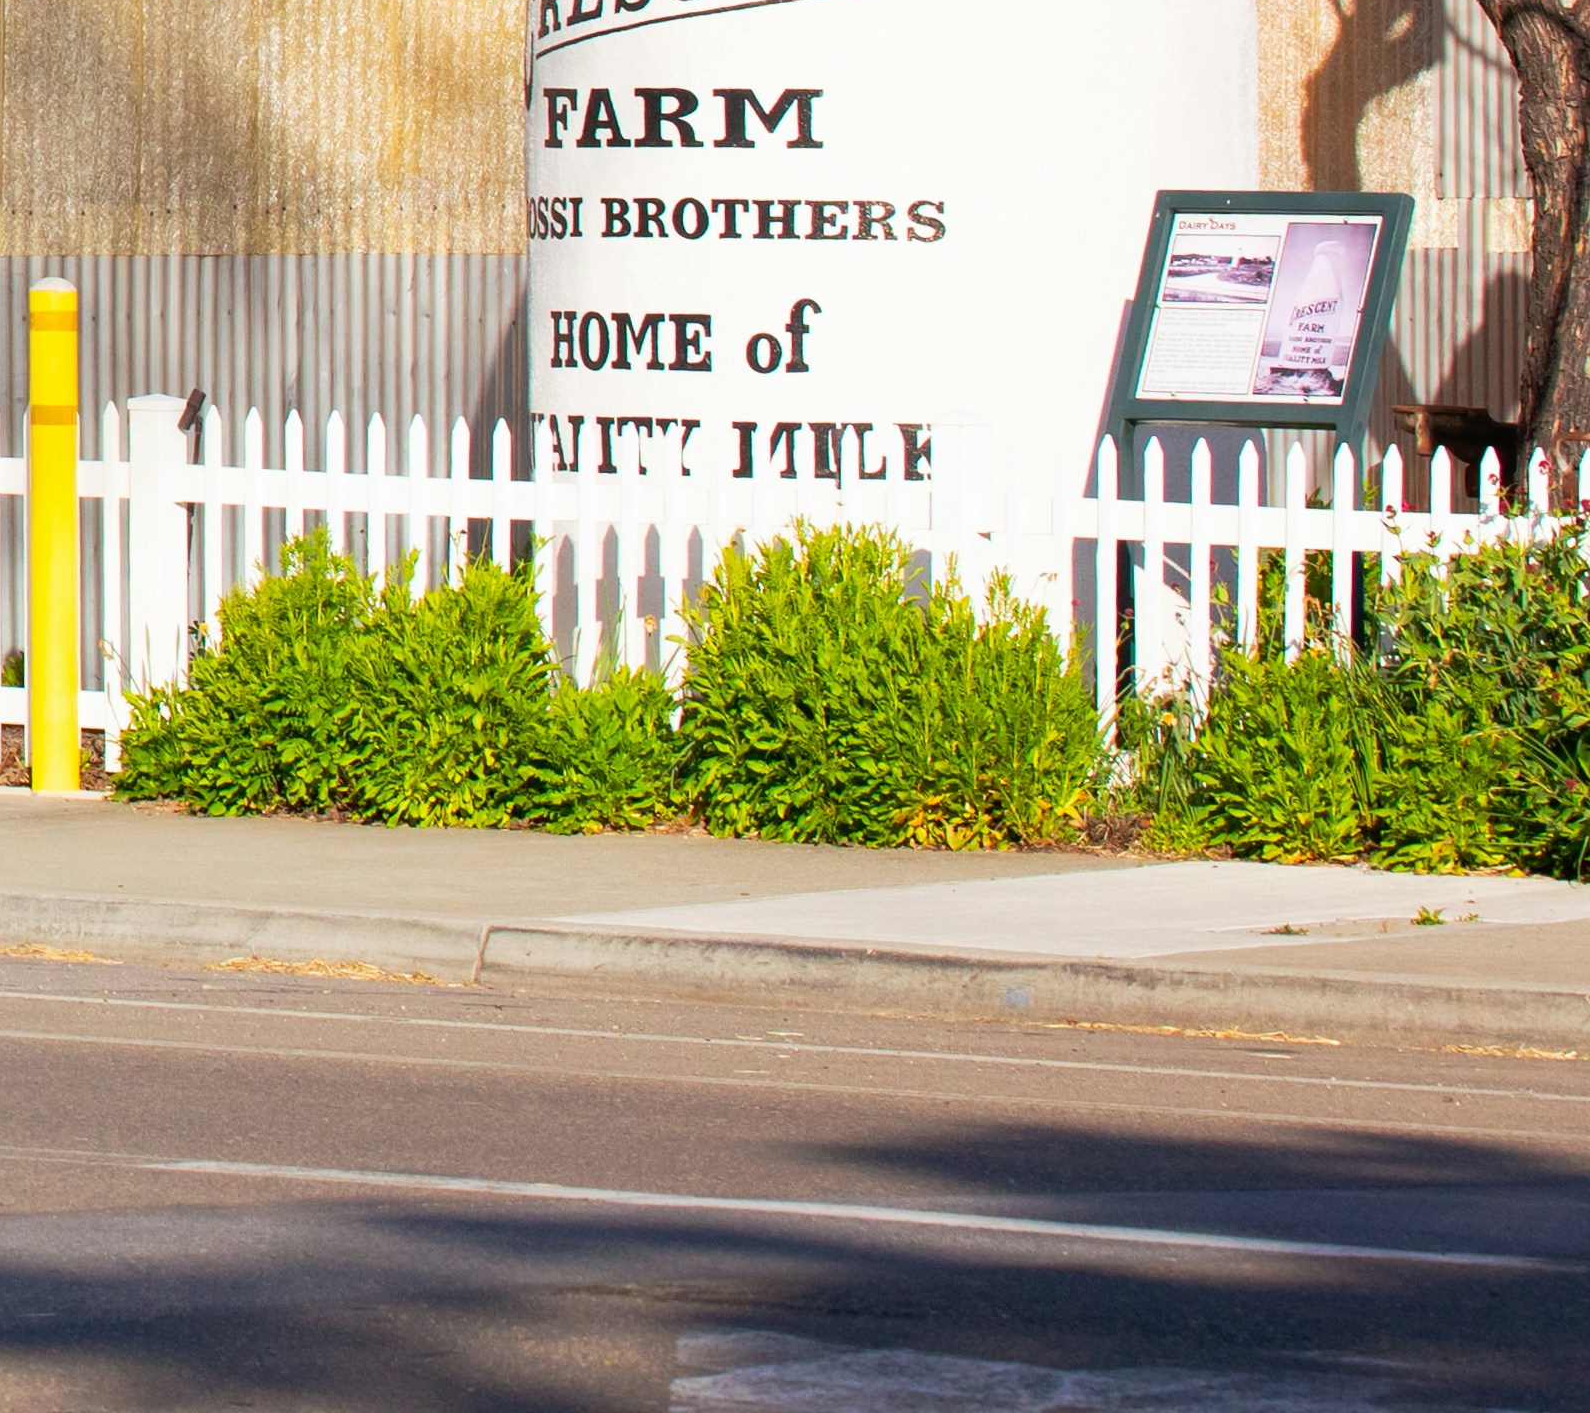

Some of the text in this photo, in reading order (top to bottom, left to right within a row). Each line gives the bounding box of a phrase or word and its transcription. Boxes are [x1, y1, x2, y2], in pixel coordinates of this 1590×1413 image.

[543, 87, 824, 150] FARM
[600, 196, 947, 244] BROTHERS
[1179, 220, 1236, 230] DAIRY DAYS
[550, 297, 822, 373] HOME of
